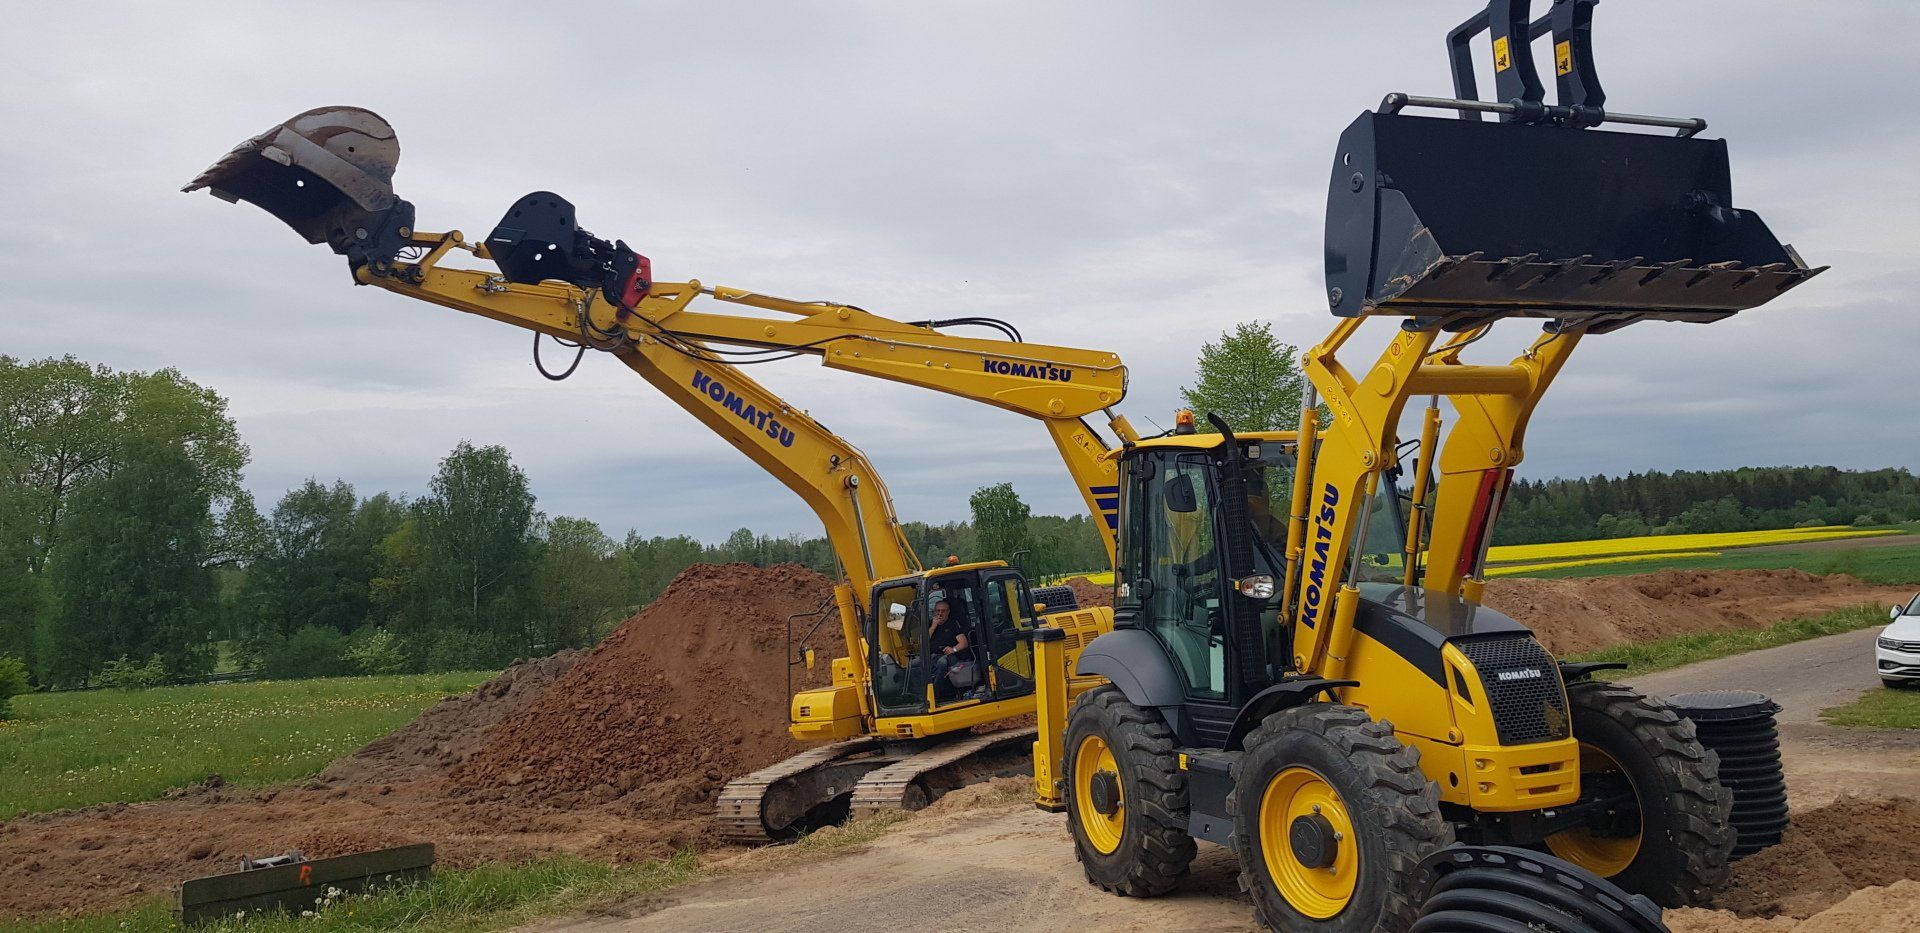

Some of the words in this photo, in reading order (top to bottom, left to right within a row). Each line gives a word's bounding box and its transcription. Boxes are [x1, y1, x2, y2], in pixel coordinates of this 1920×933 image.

[984, 360, 1072, 382] KOMATSU
[691, 369, 795, 447] KOMATSU
[1301, 483, 1339, 630] KOMATSU
[1498, 668, 1541, 680] KOMATSU
